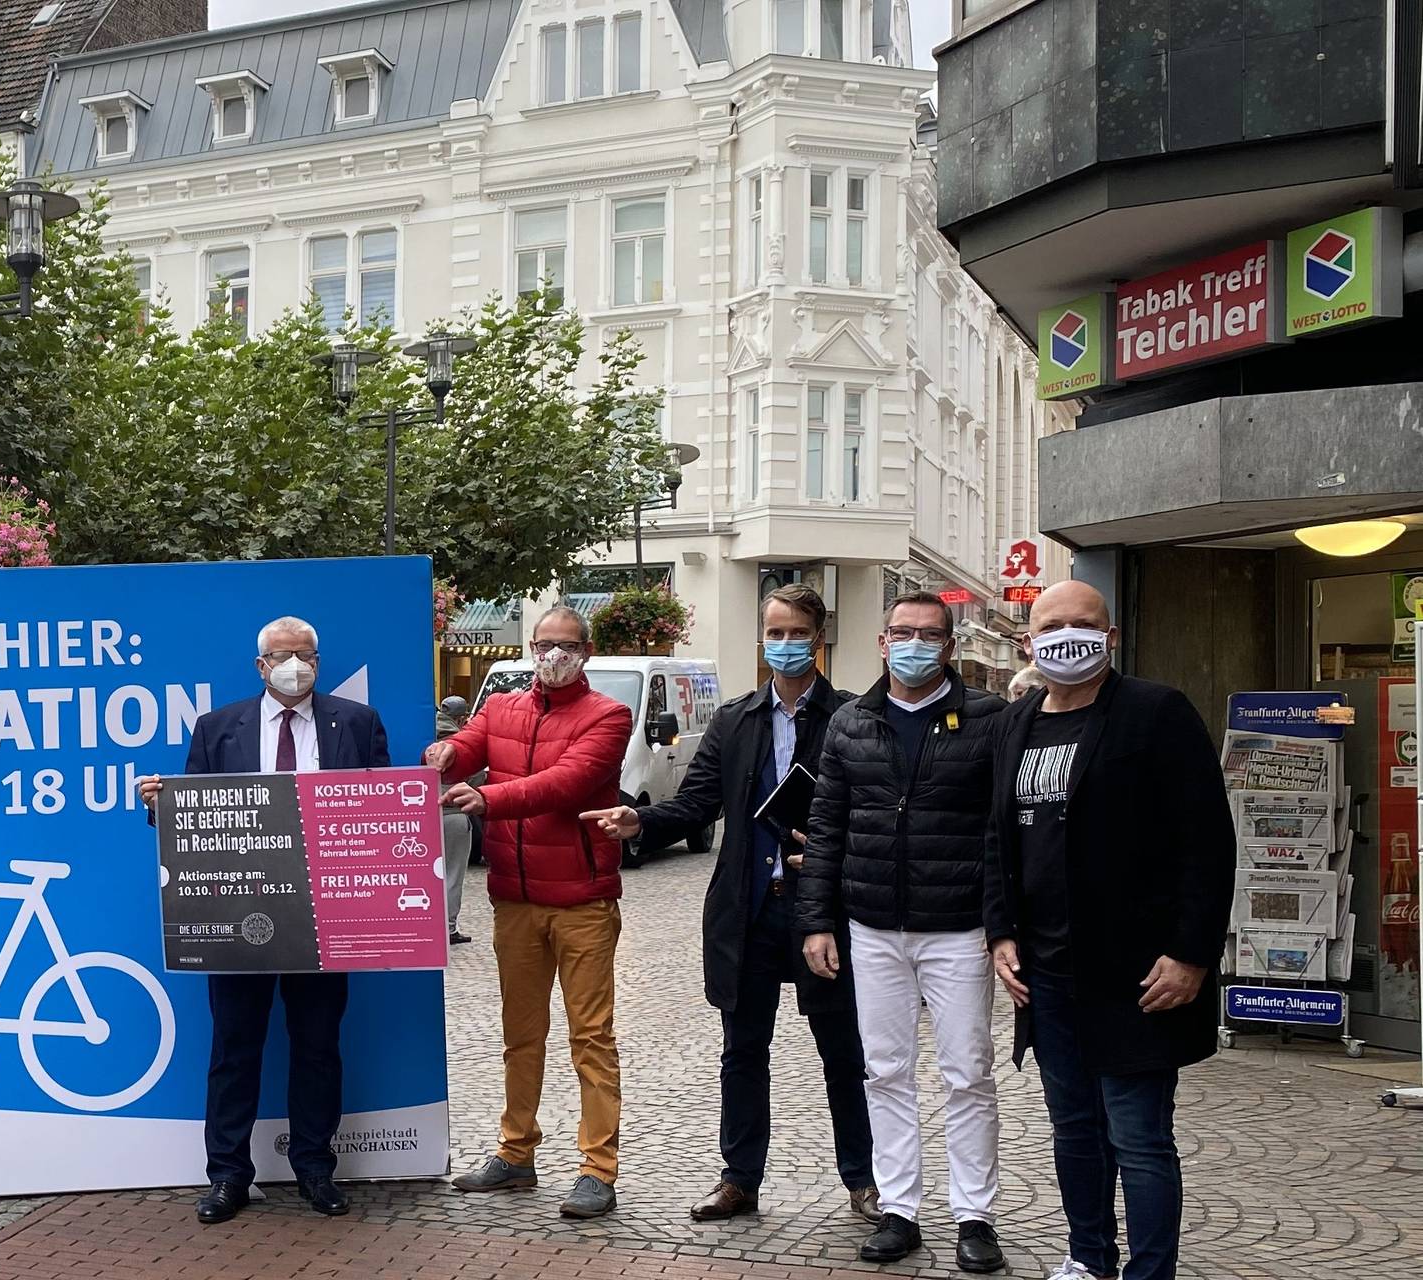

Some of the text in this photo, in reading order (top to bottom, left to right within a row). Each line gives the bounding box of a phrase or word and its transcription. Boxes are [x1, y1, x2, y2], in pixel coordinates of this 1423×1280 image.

[1119, 255, 1266, 323] Tabak Treff
[1292, 302, 1366, 329] WEST LOTTO
[1117, 299, 1265, 364] Teichler
[1042, 373, 1096, 394] WEST LOTTO
[1039, 640, 1102, 660] offline
[1237, 706, 1287, 718] Frankfurter
[1, 769, 66, 815] 18
[84, 761, 149, 813] Uh
[314, 782, 395, 797] KOSTENLOS
[174, 784, 270, 808] WIR HABEN FÜR
[315, 800, 328, 808] mit
[175, 808, 262, 830] SIE GEÖFFNET,
[318, 821, 420, 836] 5 € GUTSCHEIN
[177, 833, 292, 854] in Recklinghausen
[349, 838, 365, 846] dem
[319, 849, 348, 857] Fahrrad
[1267, 847, 1296, 857] WAZ
[178, 871, 266, 882] Aktionstage am:
[321, 873, 408, 888] FREI PARKEN
[178, 883, 297, 896] 10.10. 07.11. 05.12.
[321, 891, 334, 899] mit
[179, 924, 234, 935] DIE GUTE STUBE
[1235, 993, 1336, 1010] Frankfurter Allgemeine
[330, 1140, 417, 1154] KLINGHAUSEN
